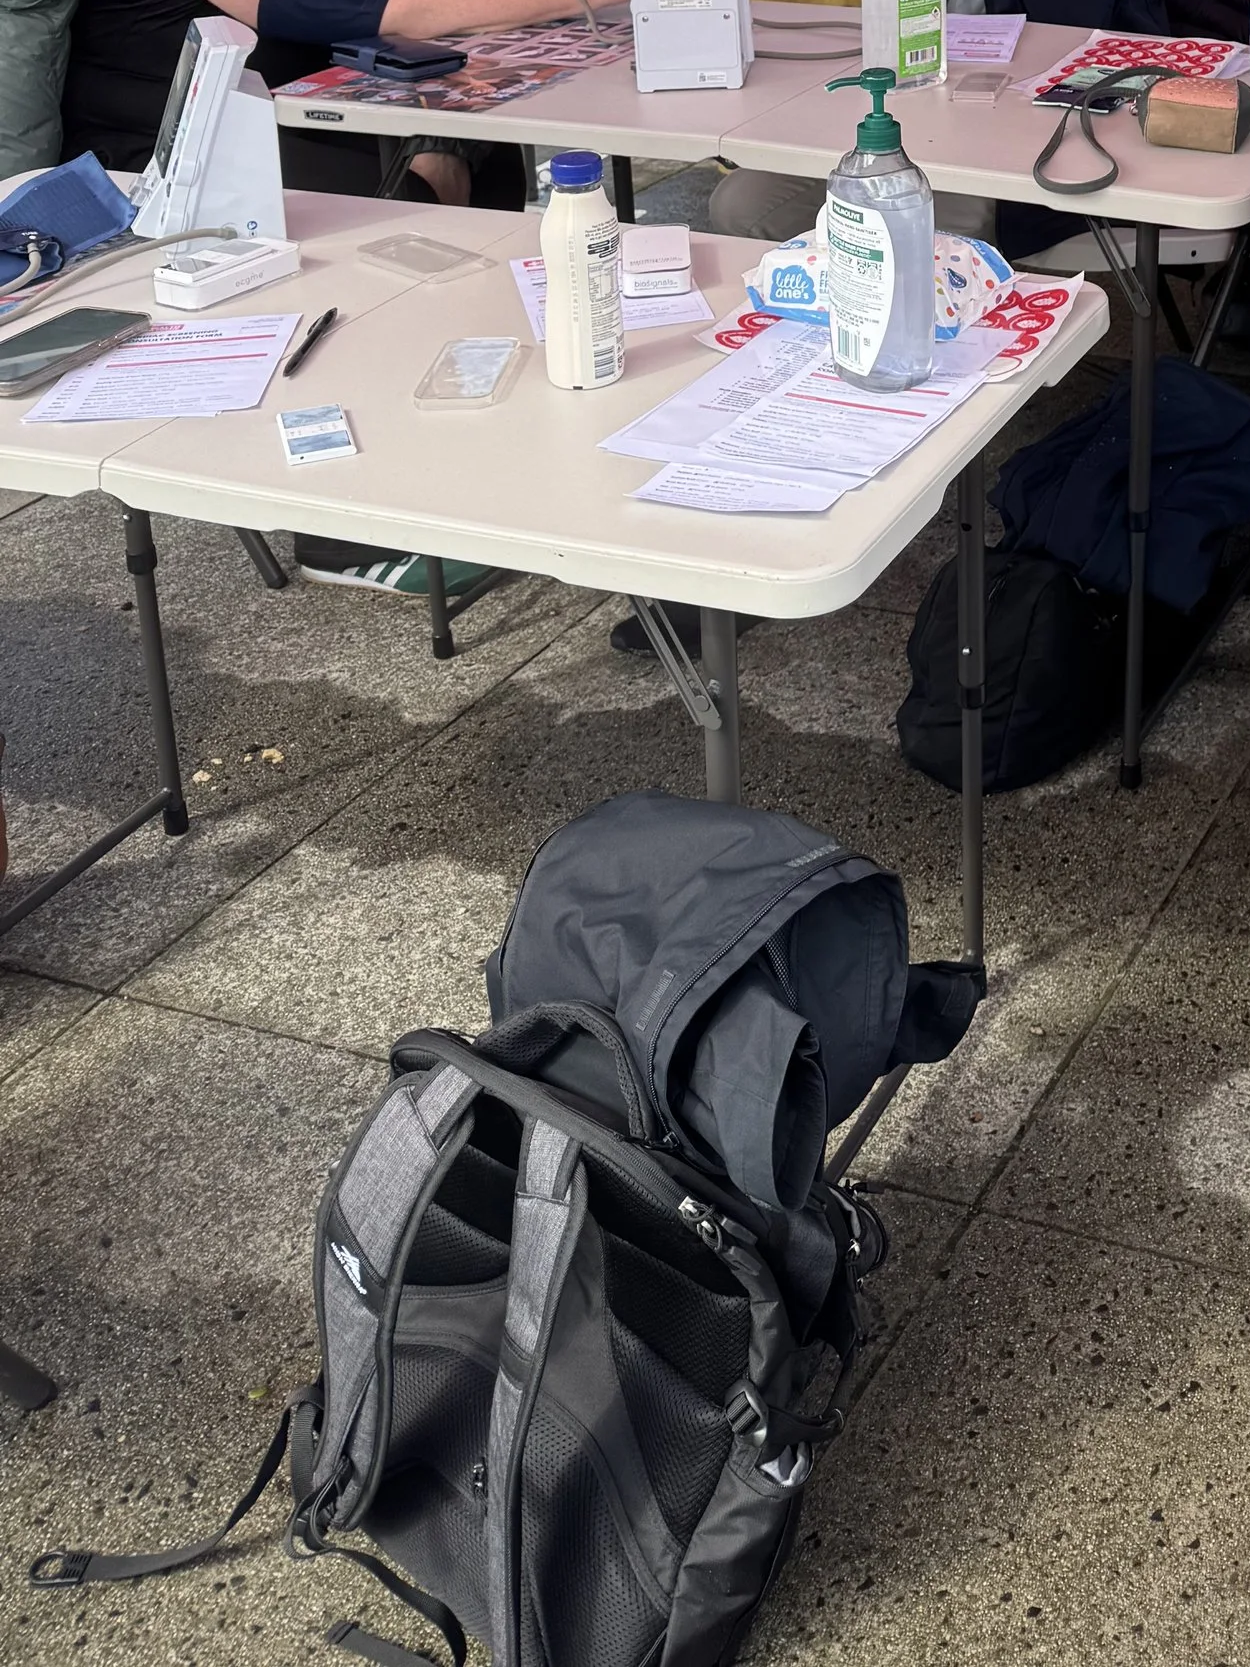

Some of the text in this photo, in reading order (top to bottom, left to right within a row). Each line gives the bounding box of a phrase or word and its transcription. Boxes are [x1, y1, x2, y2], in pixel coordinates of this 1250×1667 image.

[309, 111, 341, 121] LIFETIME
[634, 279, 673, 289] biosignals
[776, 271, 809, 291] little
[775, 288, 809, 300] one's
